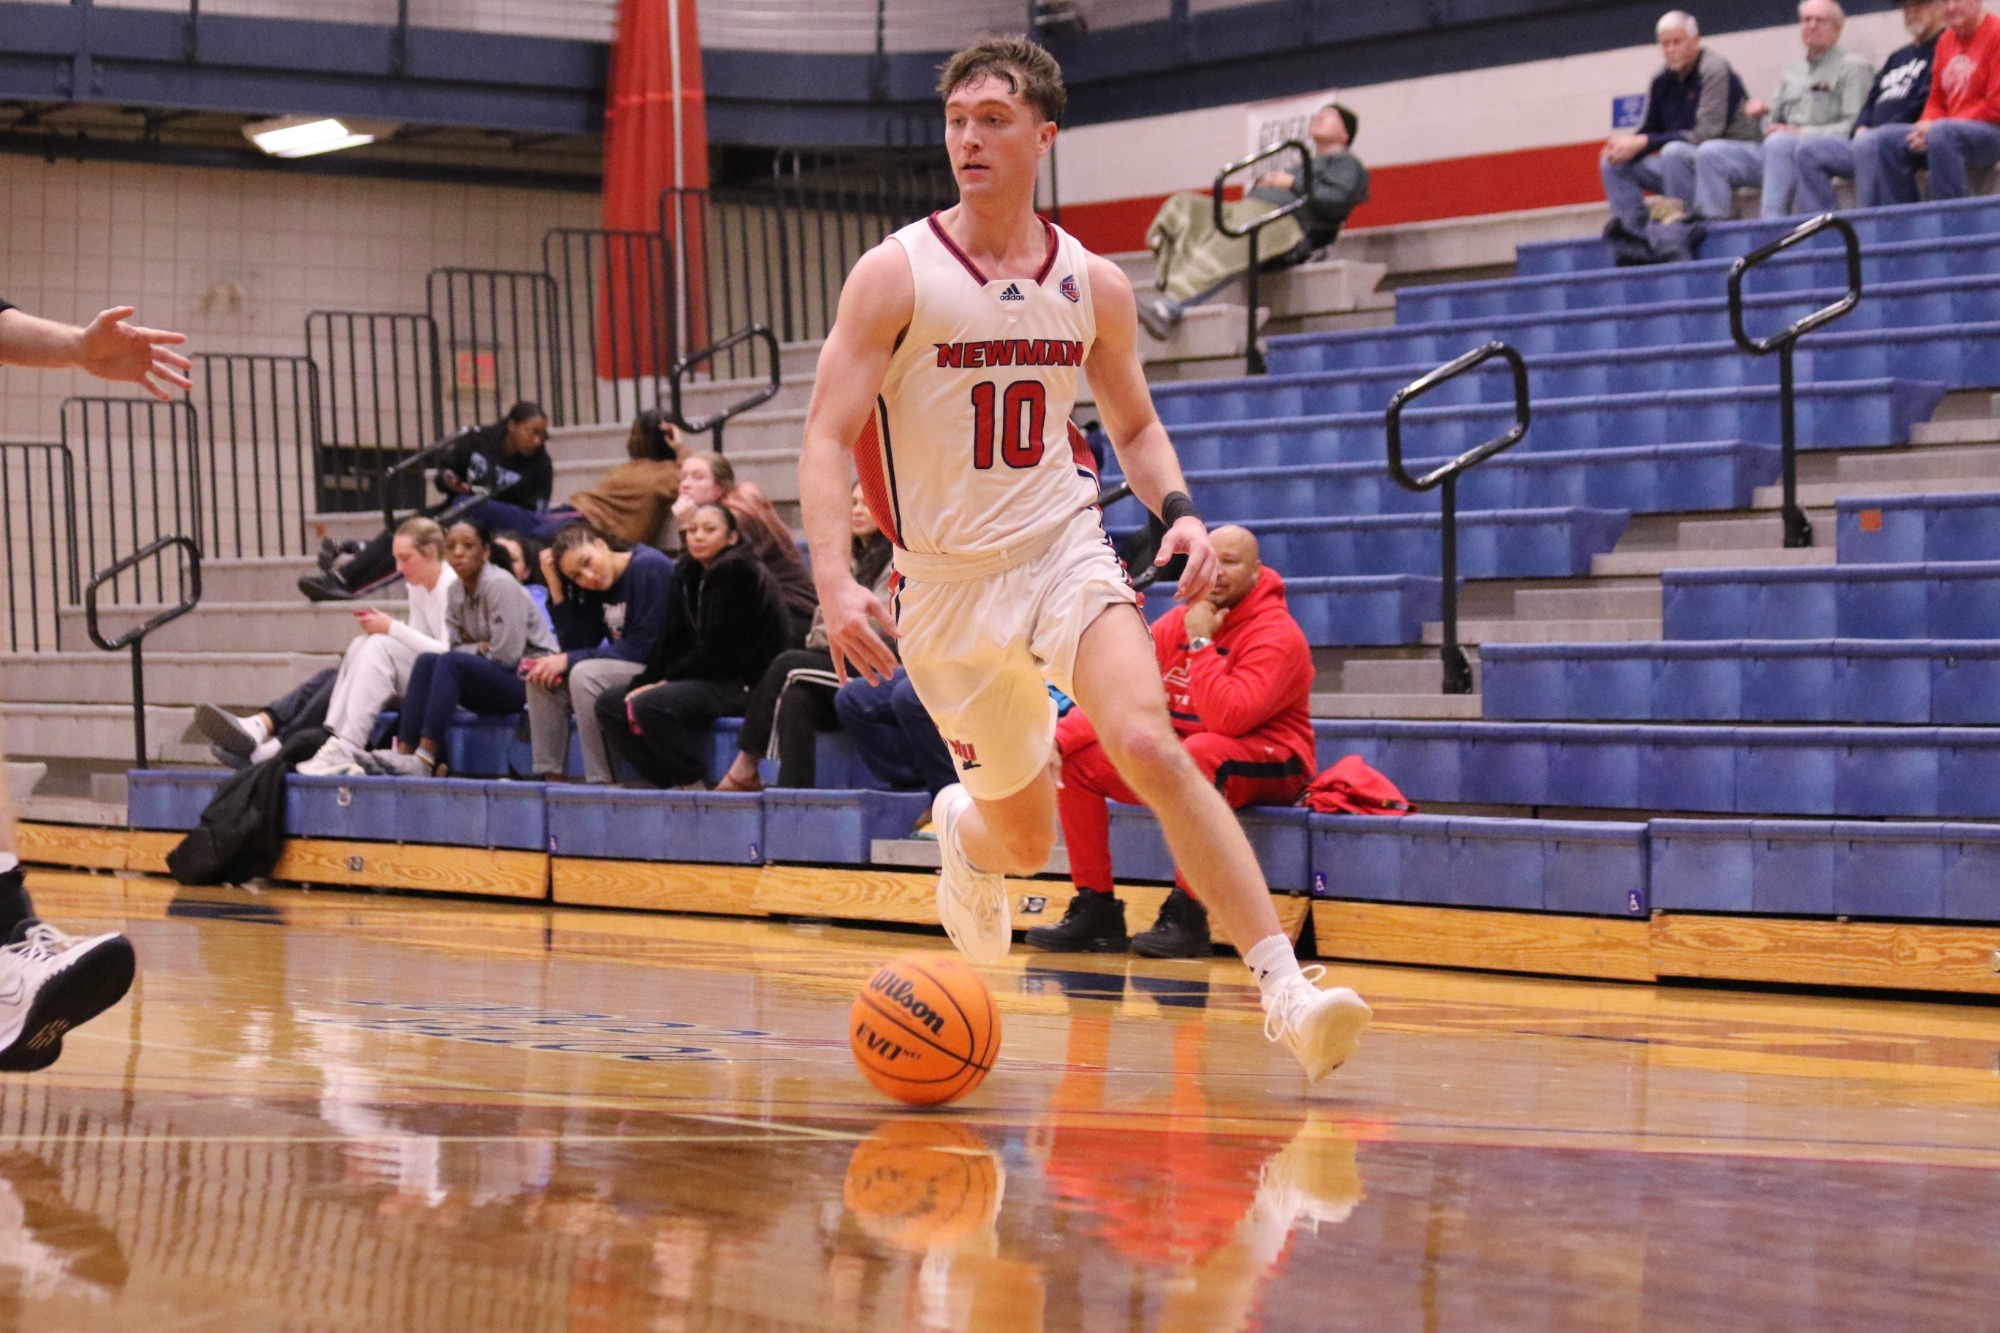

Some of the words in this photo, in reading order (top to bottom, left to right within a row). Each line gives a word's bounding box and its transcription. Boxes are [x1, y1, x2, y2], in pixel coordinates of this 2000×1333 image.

[934, 339, 1084, 368] NEWMAN
[971, 380, 1046, 469] 10
[869, 969, 945, 1038] Wilson
